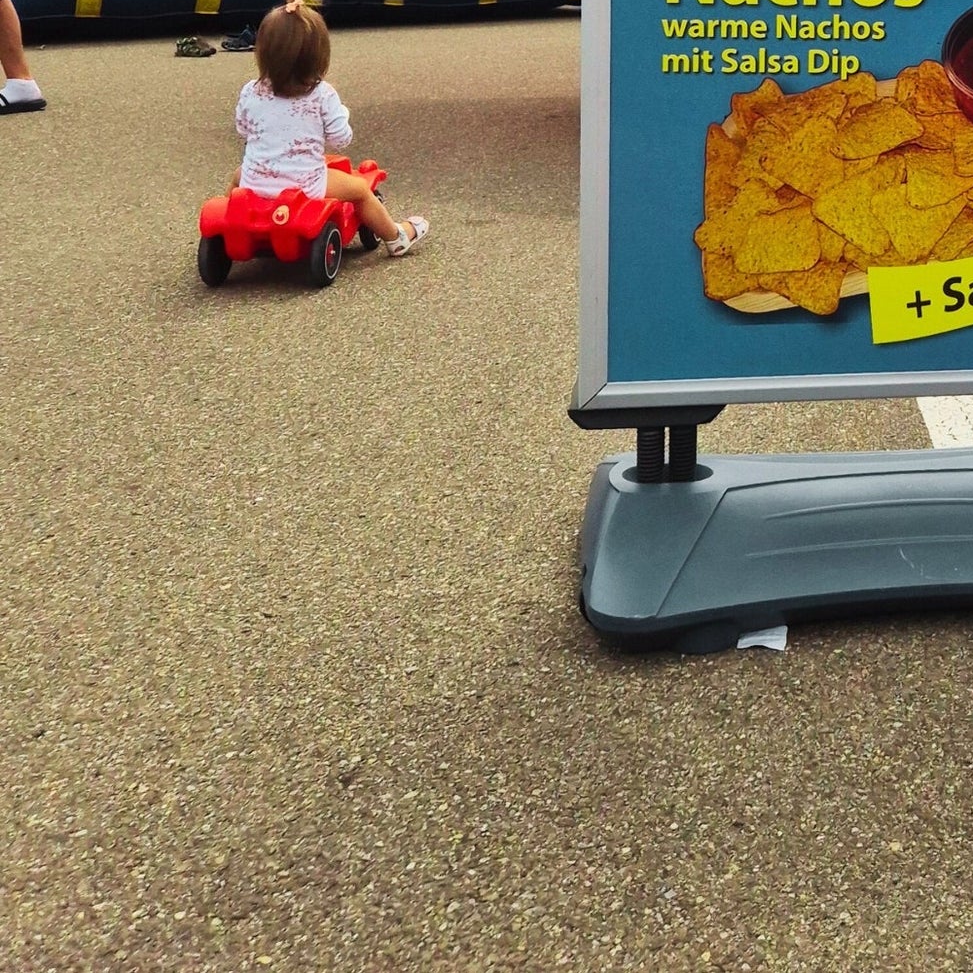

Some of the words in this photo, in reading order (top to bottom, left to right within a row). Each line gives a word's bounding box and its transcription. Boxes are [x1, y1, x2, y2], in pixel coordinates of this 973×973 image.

[661, 17, 768, 40] warme
[775, 13, 886, 41] Nachos
[661, 47, 714, 74] mit
[721, 47, 799, 75] Salsa
[807, 47, 860, 81] Dip
